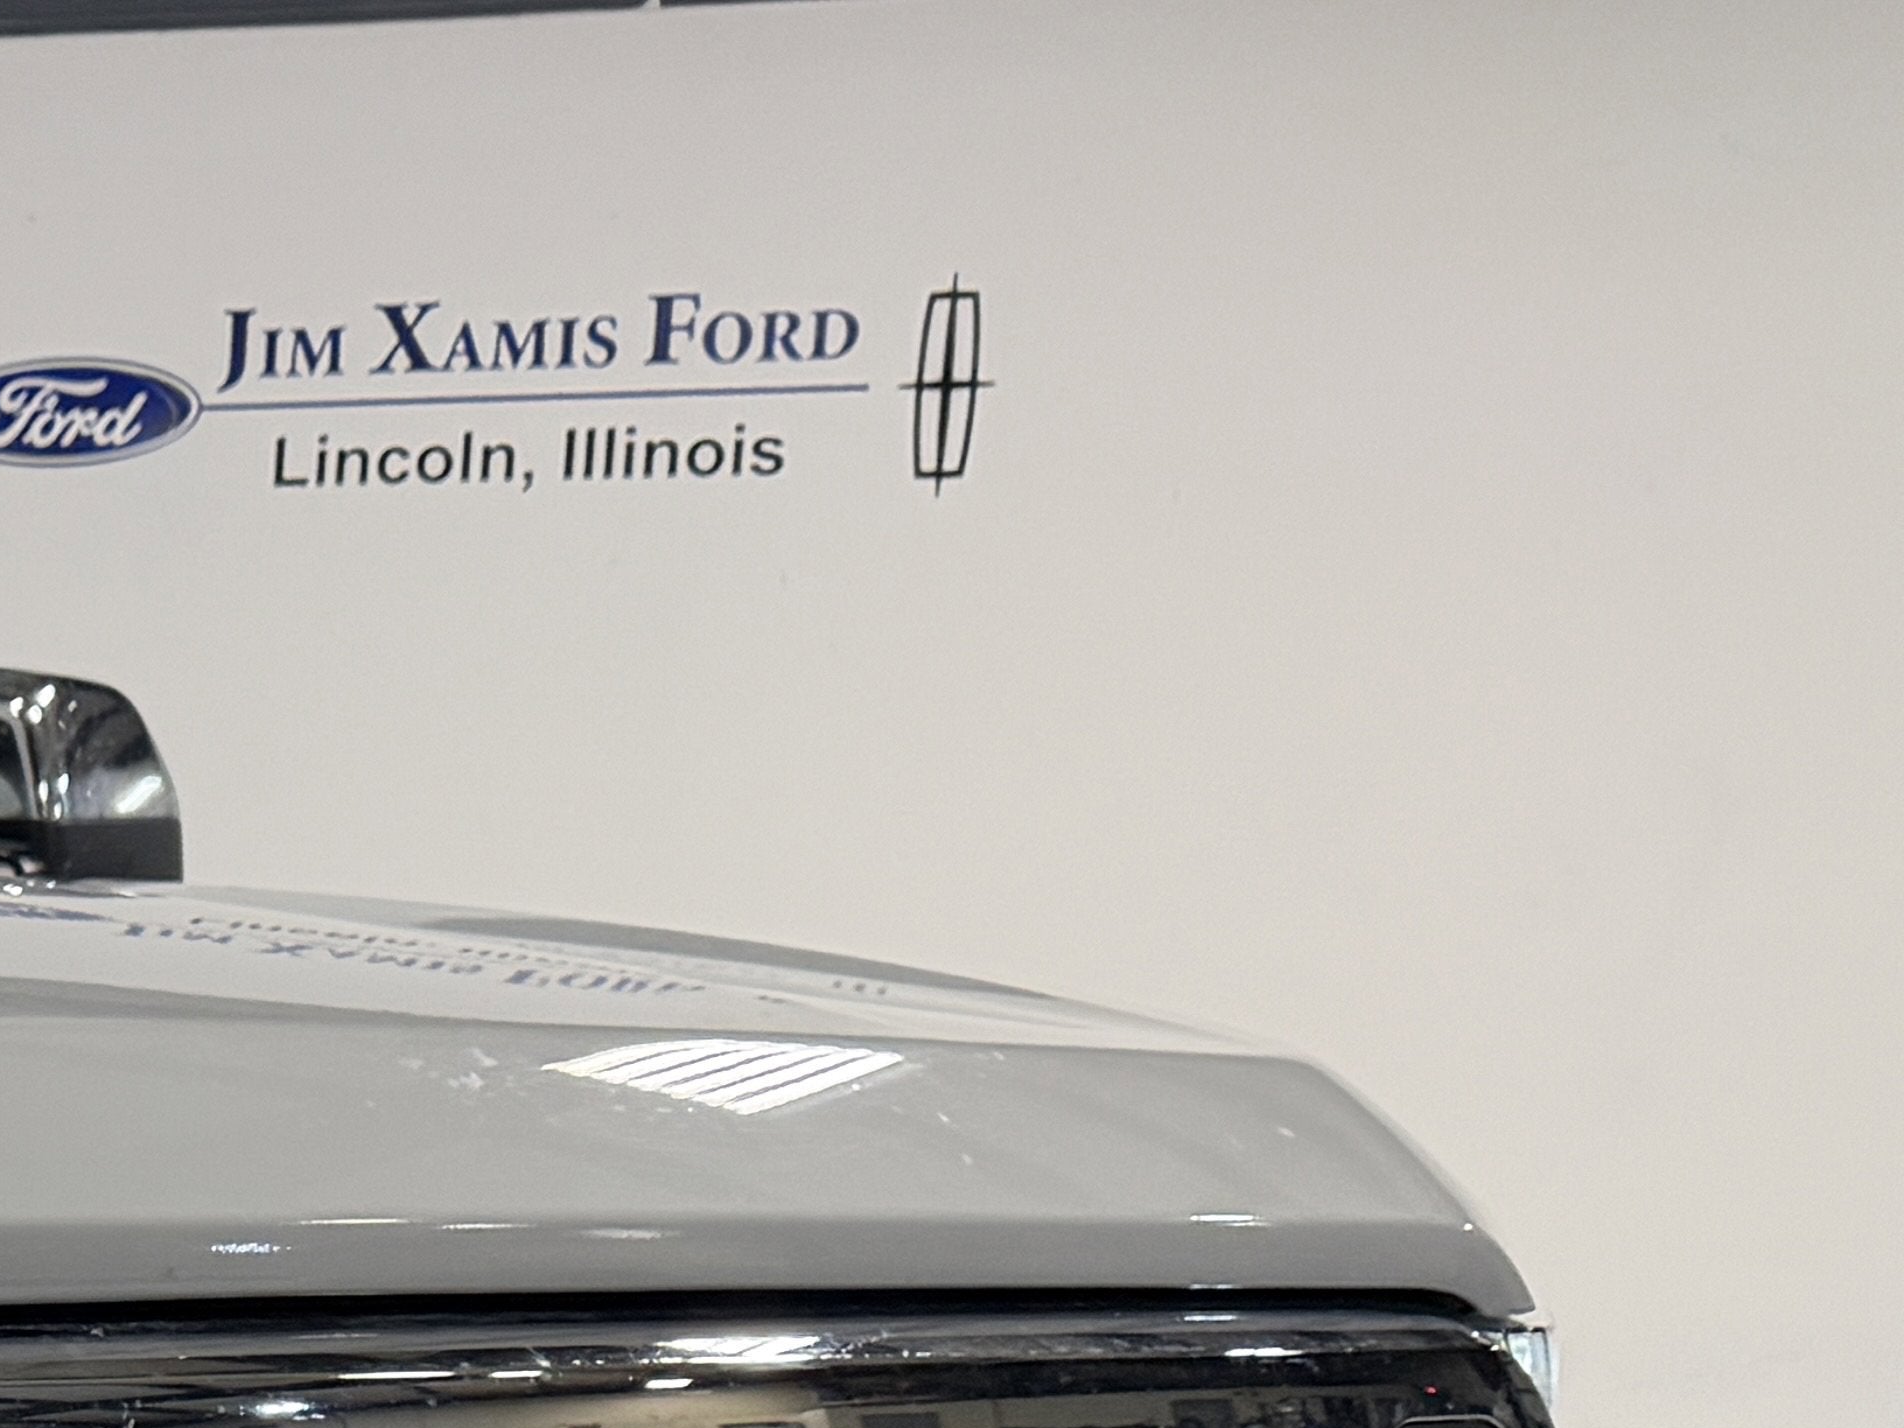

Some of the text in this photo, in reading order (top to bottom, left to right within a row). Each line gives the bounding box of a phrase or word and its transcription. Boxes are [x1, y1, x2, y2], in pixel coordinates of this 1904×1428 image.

[218, 291, 861, 394] JIM XAMIS FORD
[274, 424, 786, 493] Lincoln, Illinois
